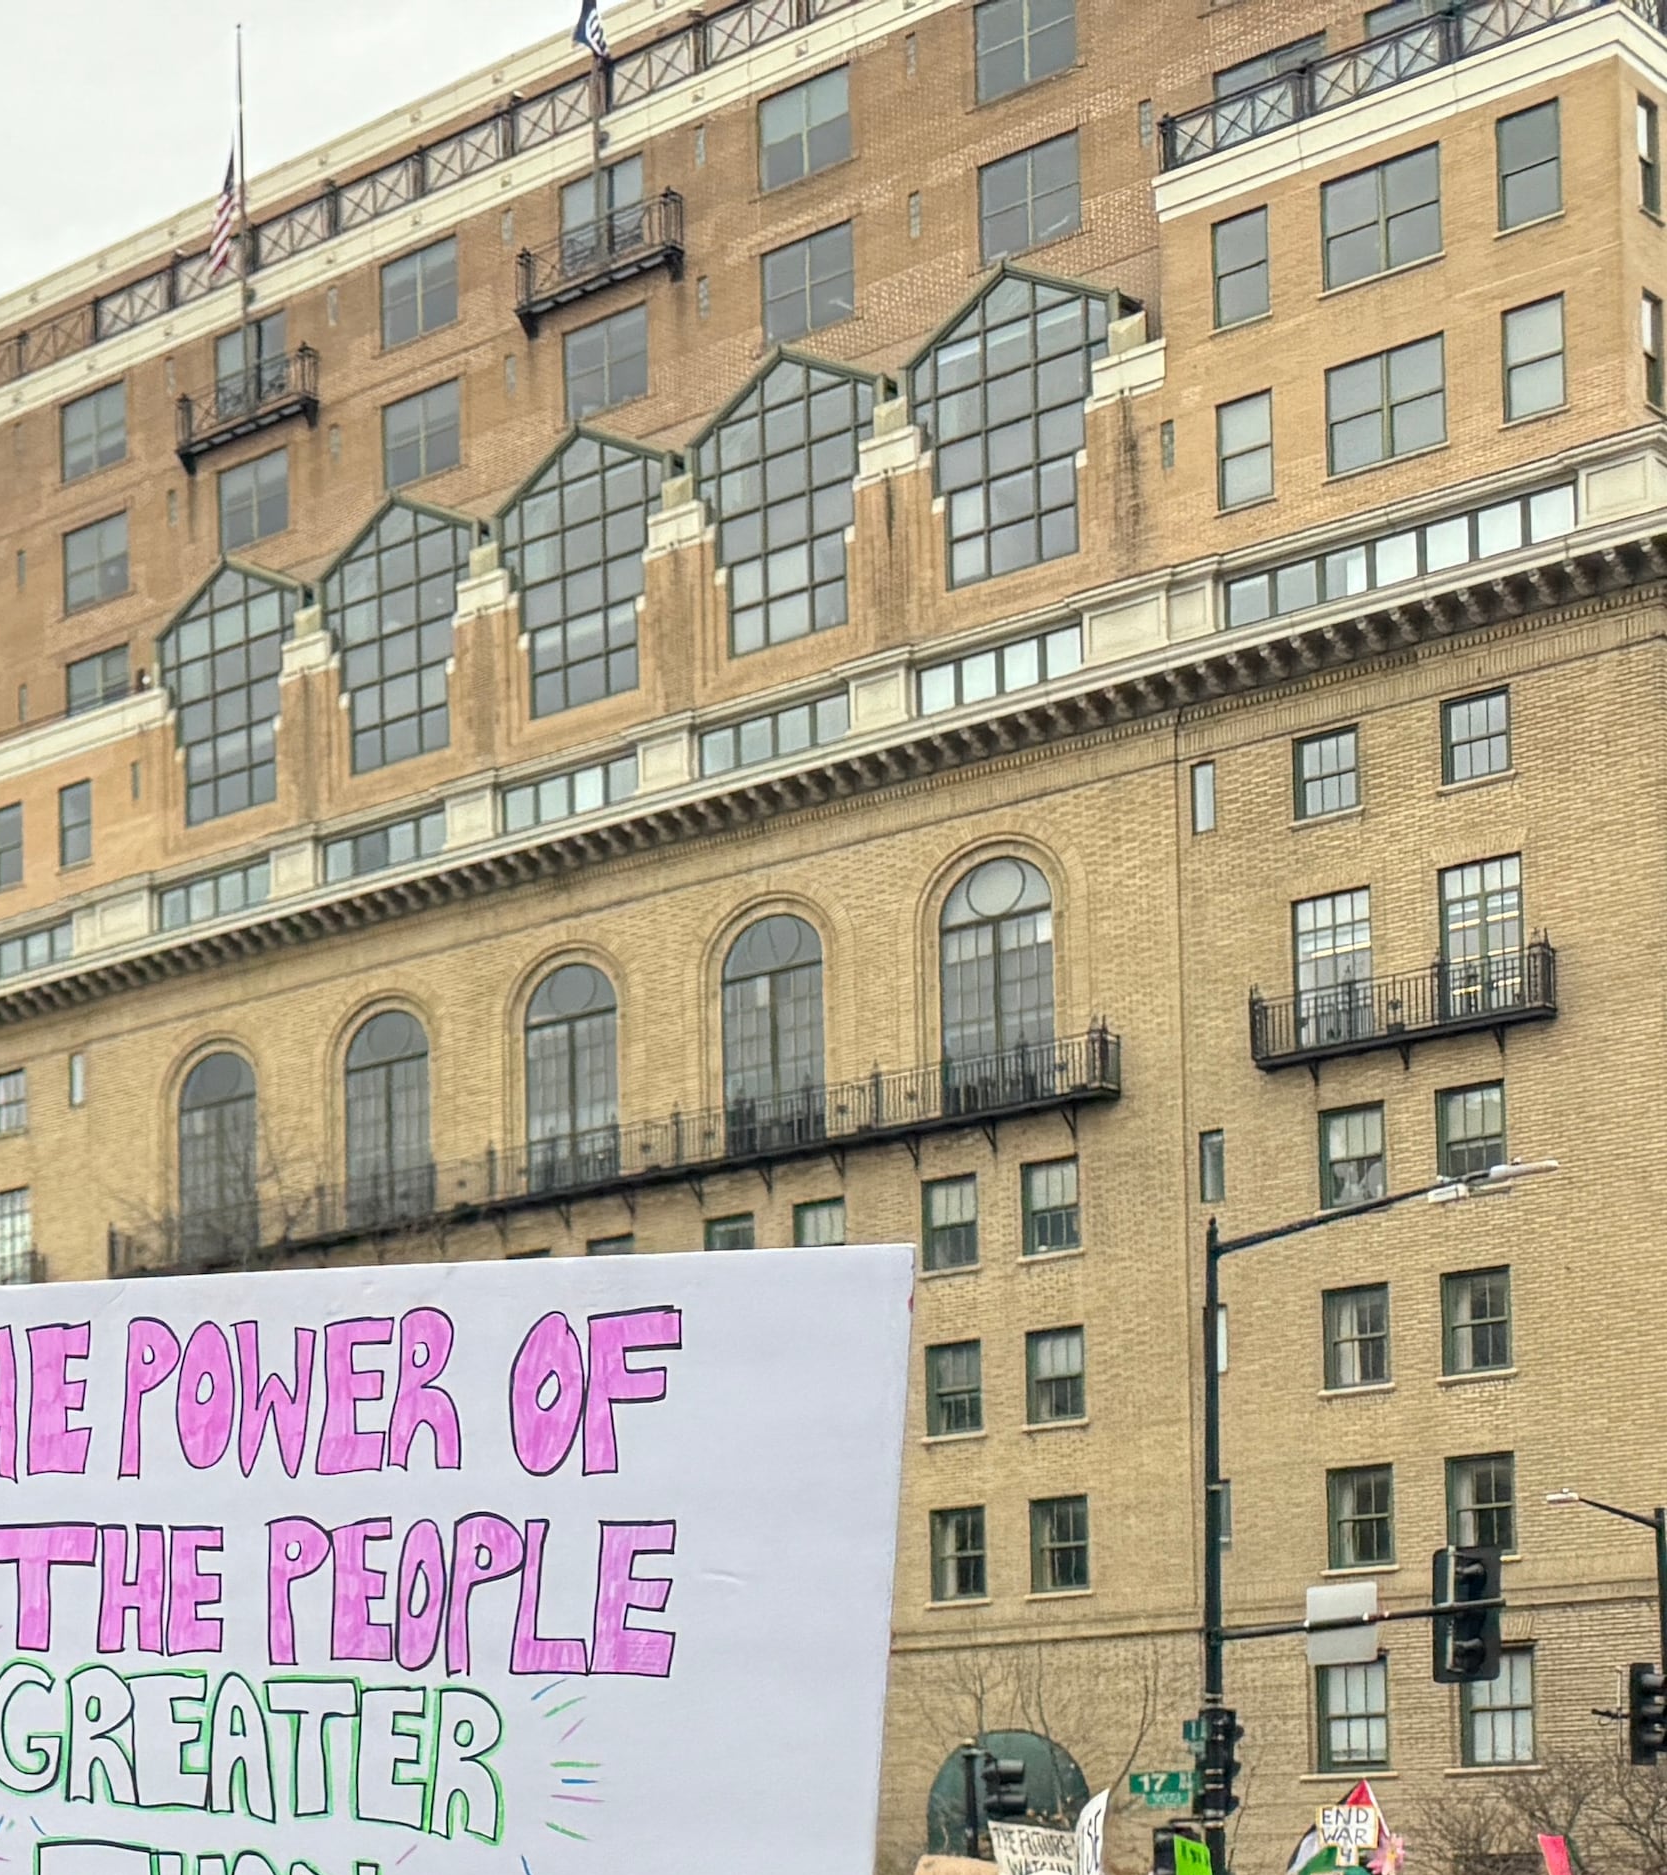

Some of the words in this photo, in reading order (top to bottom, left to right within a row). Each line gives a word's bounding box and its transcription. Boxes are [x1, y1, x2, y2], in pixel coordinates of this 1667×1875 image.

[117, 1306, 462, 1481] POWER
[510, 1306, 683, 1476] OF
[265, 1512, 679, 1680] PEOPLE
[1138, 1773, 1168, 1793] 17
[1322, 1808, 1369, 1825] END
[992, 1826, 1018, 1856] THE
[1321, 1827, 1367, 1845] WAR
[1339, 1848, 1352, 1863] 4
